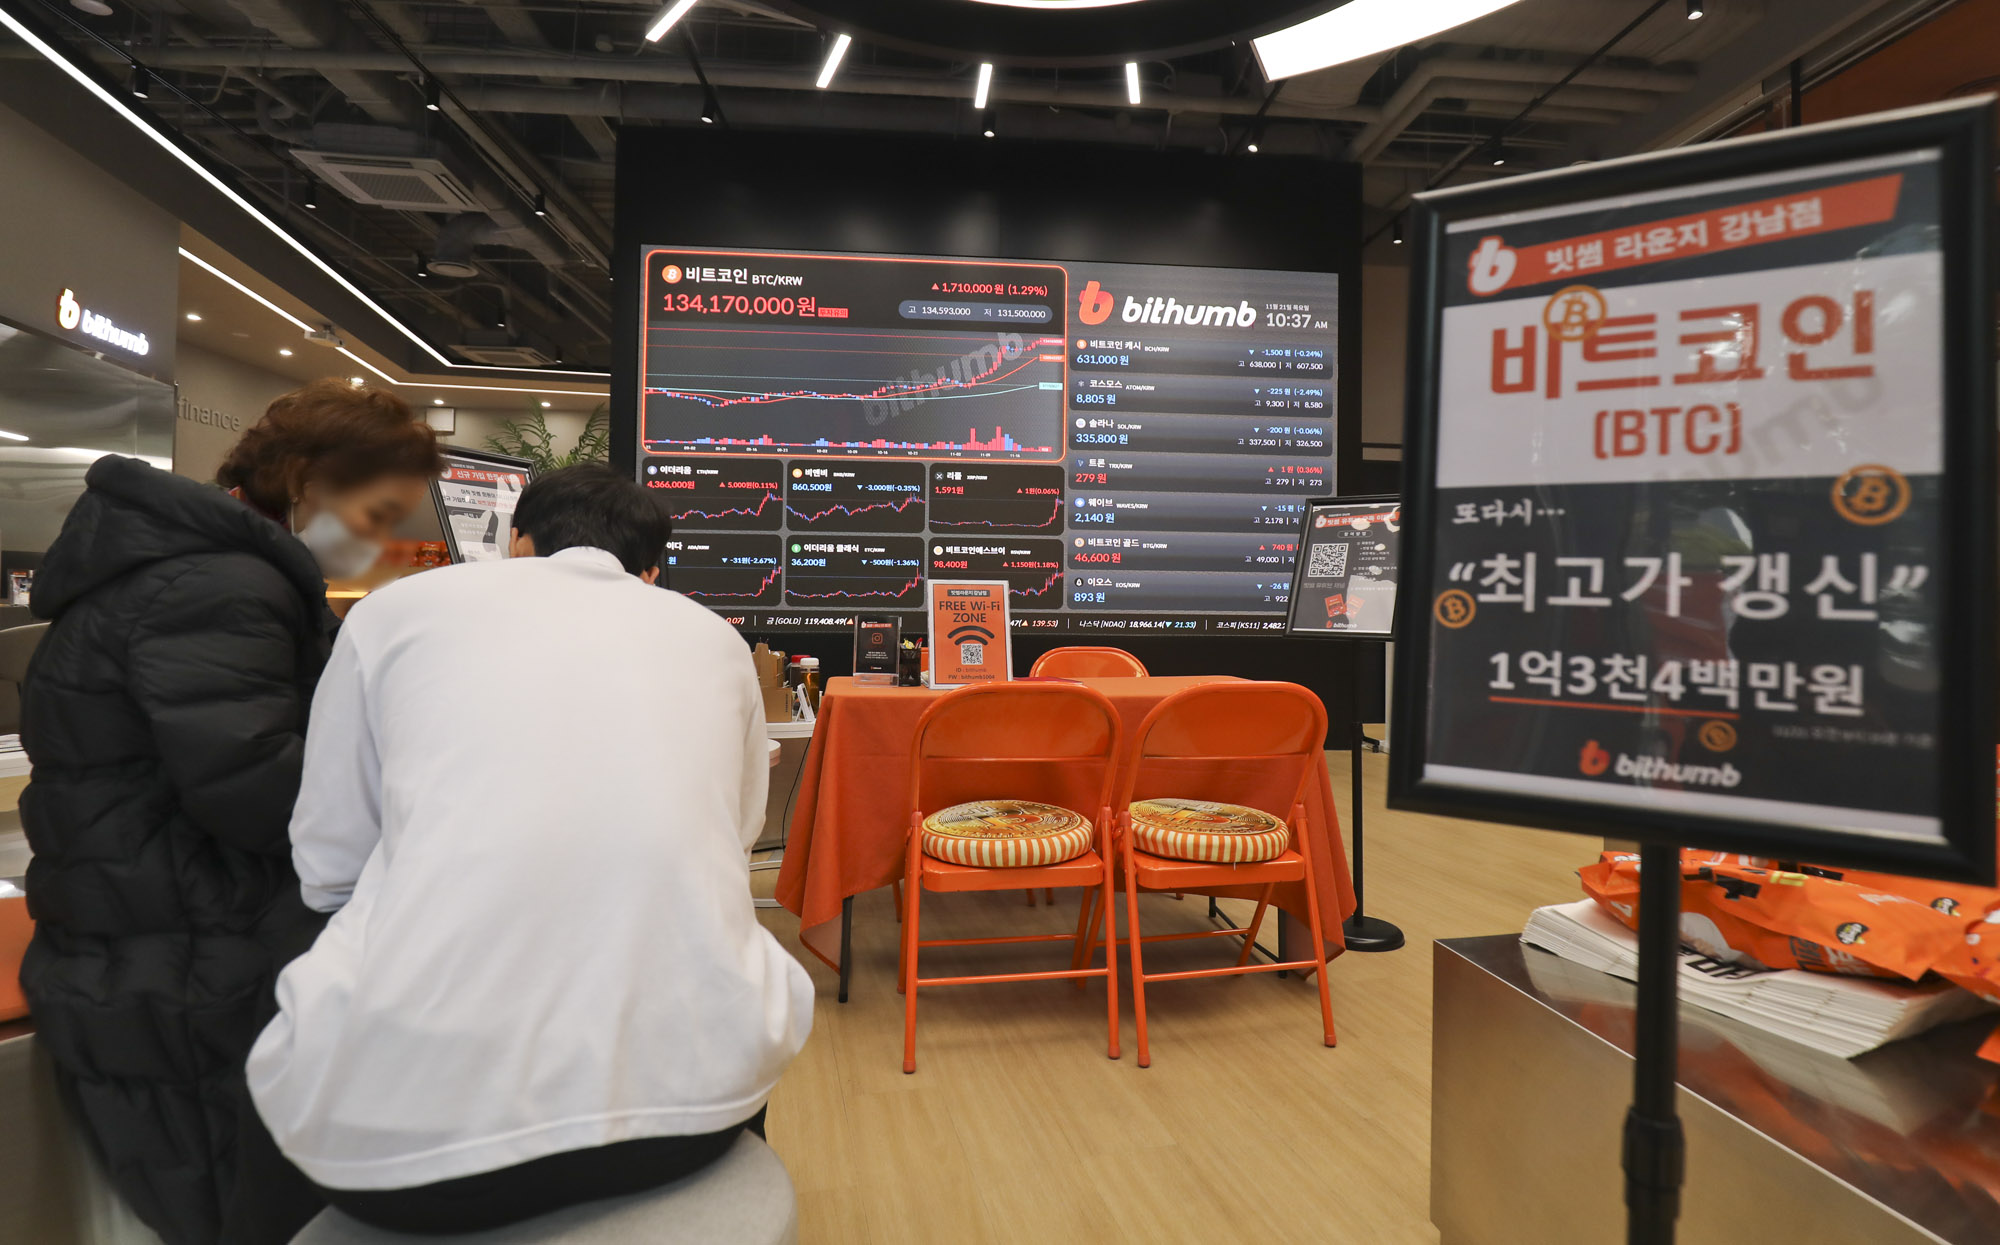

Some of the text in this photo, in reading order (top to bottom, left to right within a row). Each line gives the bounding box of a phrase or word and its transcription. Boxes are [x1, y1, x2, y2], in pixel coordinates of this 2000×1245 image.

[1546, 197, 1824, 275] 빗썸 라운지 강남점
[685, 266, 803, 287] 비트코인 BTC/KRW
[1007, 284, 1048, 297] (1.29%)
[921, 305, 971, 317] 134,593,000
[997, 308, 1046, 319] 131,500,000
[1121, 295, 1257, 328] bithumb
[1266, 312, 1328, 329] 10:37 AM
[82, 309, 149, 356] bithumb
[1089, 340, 1123, 350] 비트코인
[1124, 341, 1142, 351] 캐시
[1490, 290, 1876, 400] 비트코인
[1076, 354, 1118, 366] 631,000
[1089, 380, 1123, 389] 코스모스
[1076, 393, 1105, 404] 8,805
[177, 397, 241, 432] finance
[1089, 418, 1114, 428] 솔라나
[1076, 433, 1117, 445] 335,800
[1088, 458, 1105, 468] 트론
[660, 465, 692, 475] 이더리움
[805, 468, 828, 477] 비엔비
[1075, 473, 1096, 484] 279
[1276, 478, 1289, 486] 279
[792, 483, 832, 491] 860,500원
[935, 486, 964, 495] 1,591원
[1088, 498, 1113, 508] 웨이브
[1075, 512, 1103, 524] 2,140
[666, 541, 683, 550] 이다
[803, 543, 835, 552] 이더리움
[1088, 538, 1121, 548] 비트코인
[1123, 538, 1140, 548] 골드
[791, 558, 827, 566] 36,200원
[1074, 552, 1110, 563] 46,600
[933, 560, 968, 568] 98,400원
[1087, 578, 1113, 587] 이오스
[1074, 592, 1094, 602] 893
[1275, 595, 1288, 603] 922
[939, 601, 1000, 611] FREE Wi-Fi
[775, 616, 802, 626] [GOLD]
[953, 613, 987, 623] ZONE
[1079, 620, 1100, 628] 나스닥
[1100, 620, 1126, 629] [NDAQ]
[1216, 621, 1236, 629] 코스피
[1237, 621, 1260, 630] [KS11]
[1488, 651, 1865, 717] 1억3천4백만원
[1615, 754, 1741, 788] bithumb
